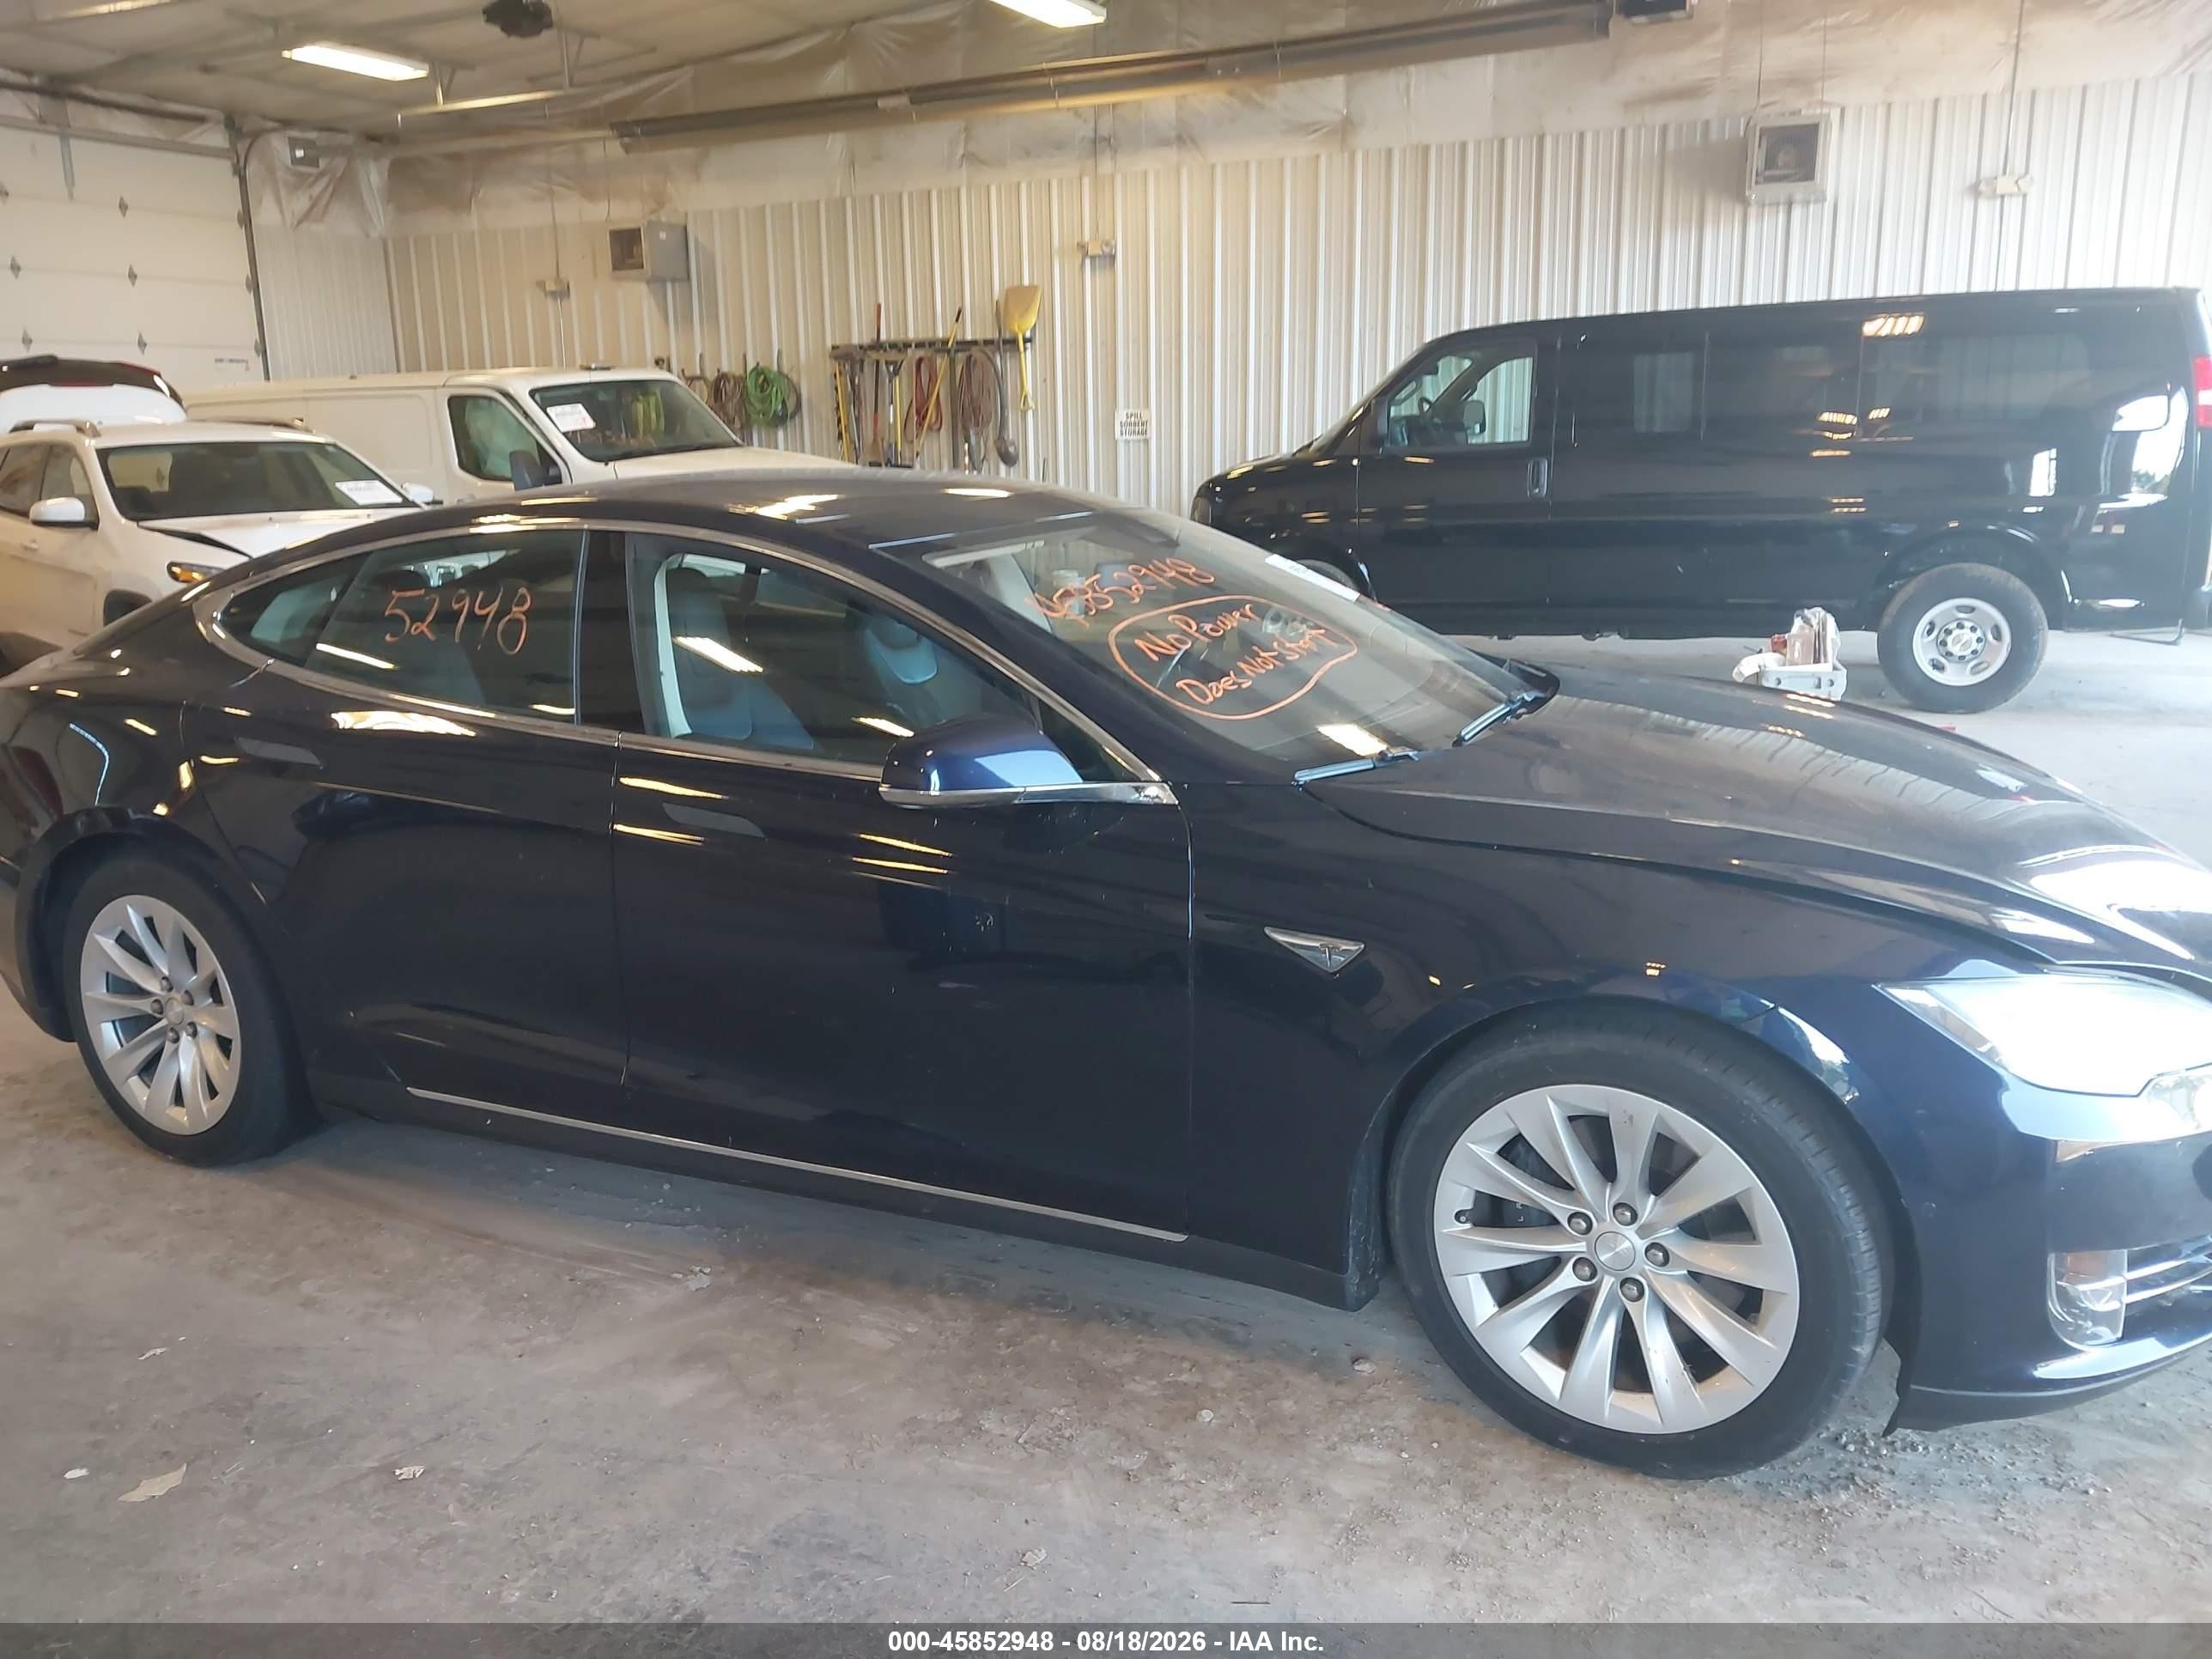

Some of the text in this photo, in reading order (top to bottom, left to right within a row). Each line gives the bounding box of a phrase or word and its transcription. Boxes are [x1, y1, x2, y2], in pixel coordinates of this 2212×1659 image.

[384, 586, 533, 656] 52948
[1134, 604, 1260, 661] No Power
[1176, 670, 1253, 705] Does
[1236, 645, 1285, 678] Not
